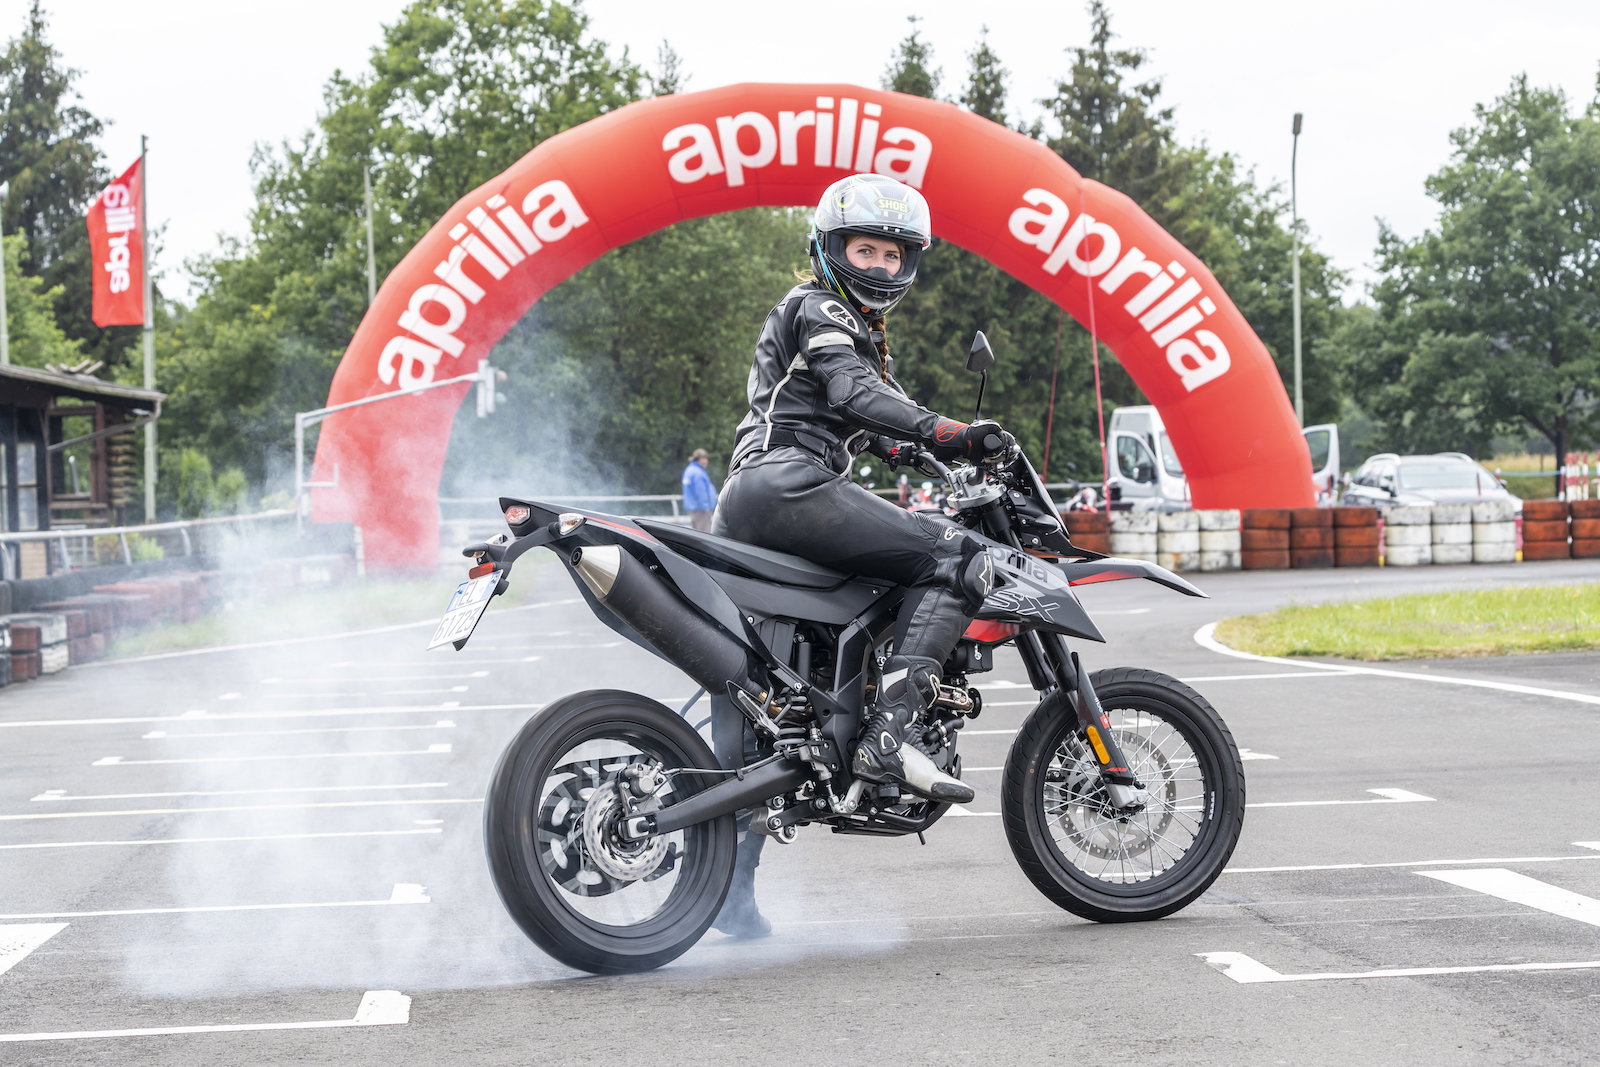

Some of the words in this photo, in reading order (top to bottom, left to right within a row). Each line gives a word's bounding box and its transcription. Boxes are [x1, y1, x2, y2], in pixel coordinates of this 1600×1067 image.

[662, 96, 932, 189] aprilia
[377, 179, 590, 395] aprilia
[1008, 188, 1231, 392] aprilia
[988, 548, 1048, 583] prilia
